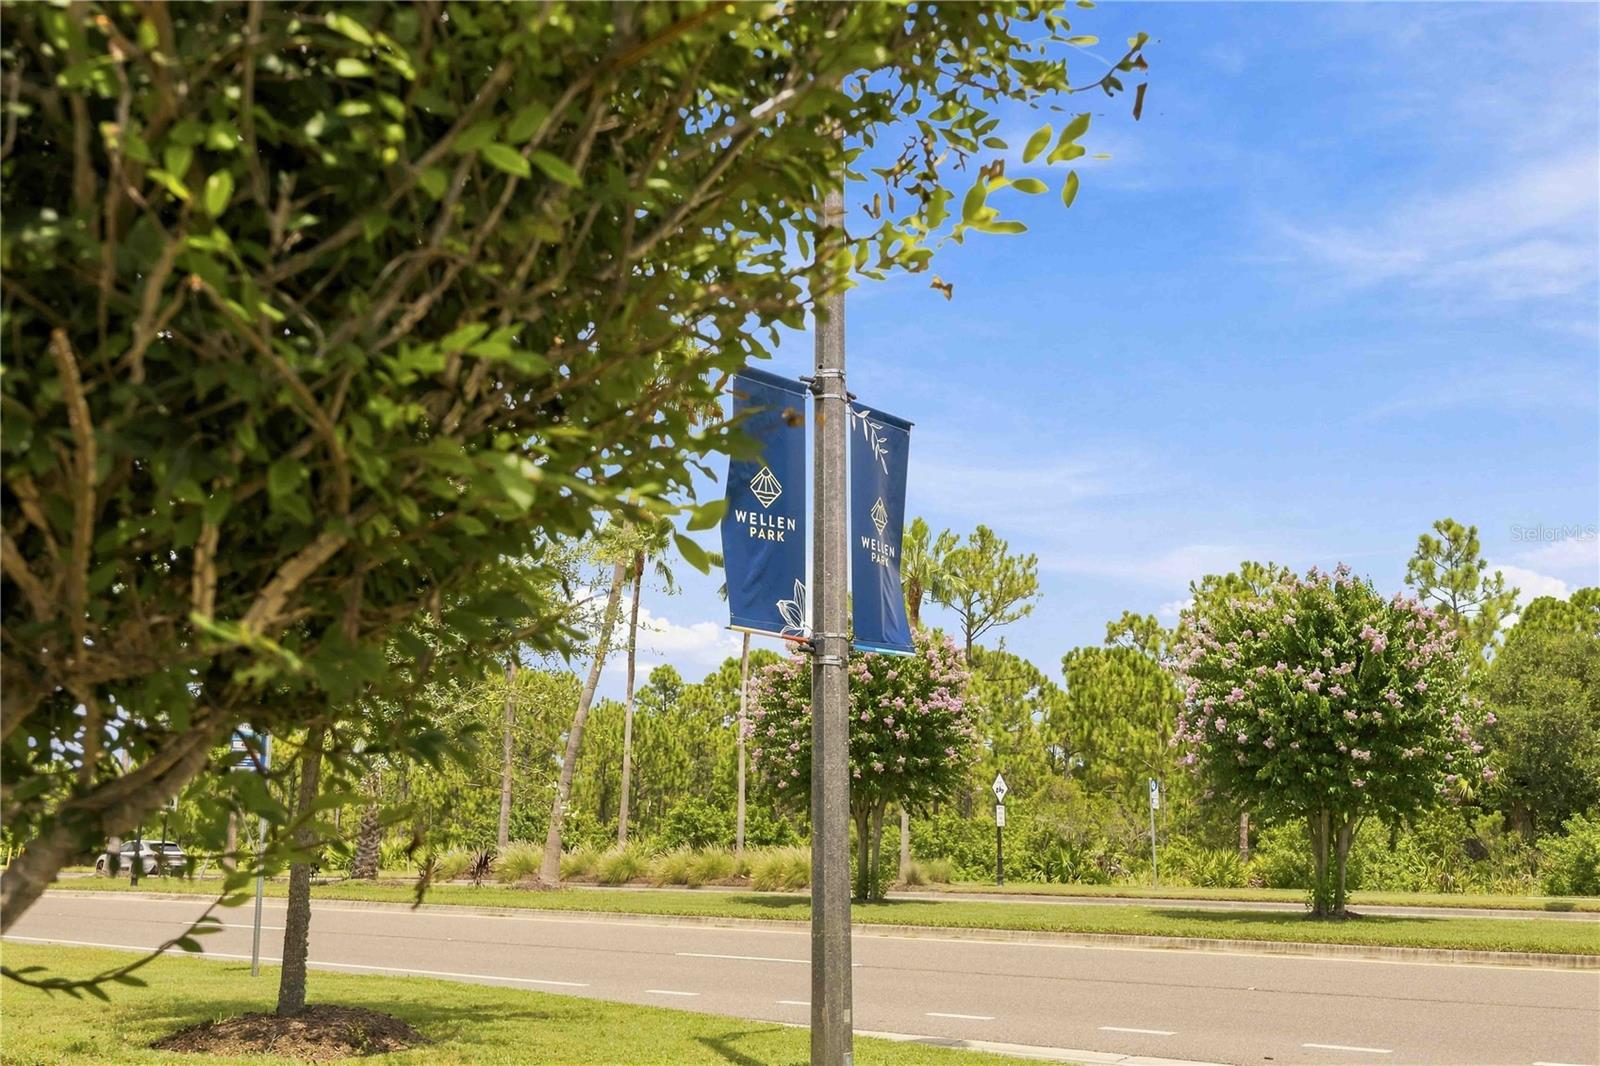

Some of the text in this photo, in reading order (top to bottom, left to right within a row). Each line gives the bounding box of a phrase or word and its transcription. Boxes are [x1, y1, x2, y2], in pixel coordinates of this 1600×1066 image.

[735, 509, 796, 531] WELLEN
[750, 527, 785, 542] PARK
[861, 535, 895, 558] WELLEN
[871, 552, 889, 568] PARK
